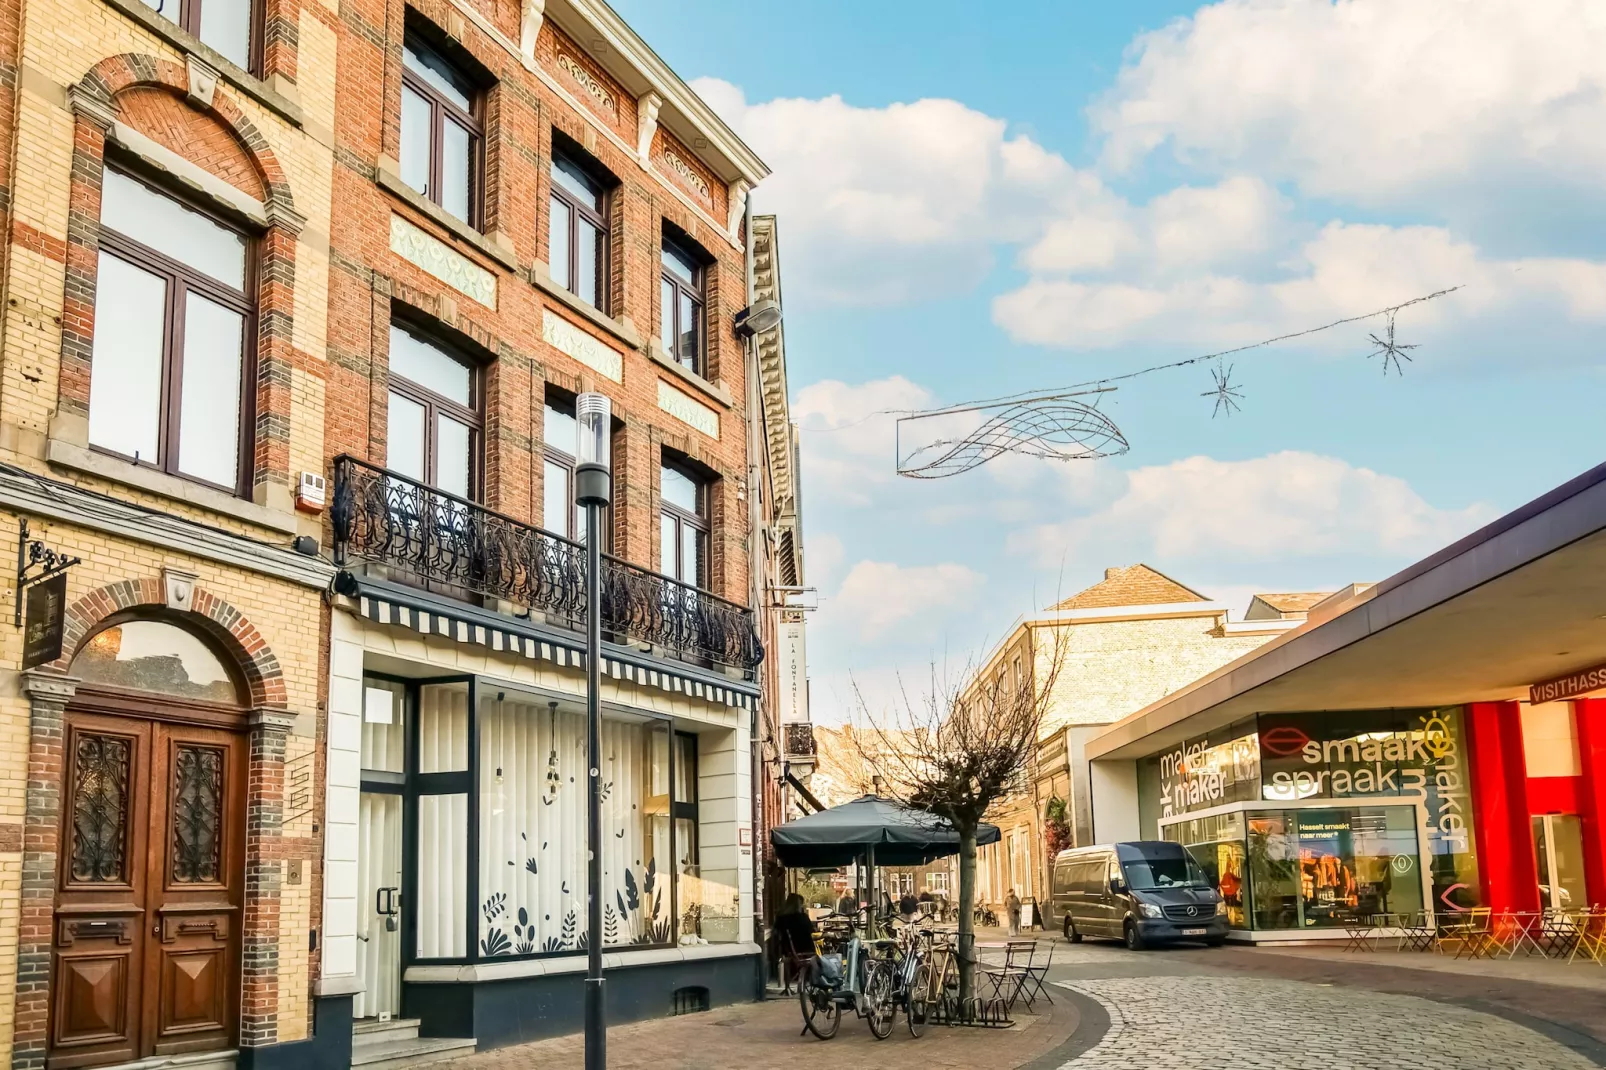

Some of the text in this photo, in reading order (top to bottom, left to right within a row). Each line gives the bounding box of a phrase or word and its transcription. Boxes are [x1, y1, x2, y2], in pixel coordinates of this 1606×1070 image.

[1160, 740, 1208, 780] maker
[1302, 731, 1431, 764] smaak
[1174, 770, 1227, 809] maker
[1272, 762, 1398, 799] spraak
[1435, 737, 1467, 849] maker
